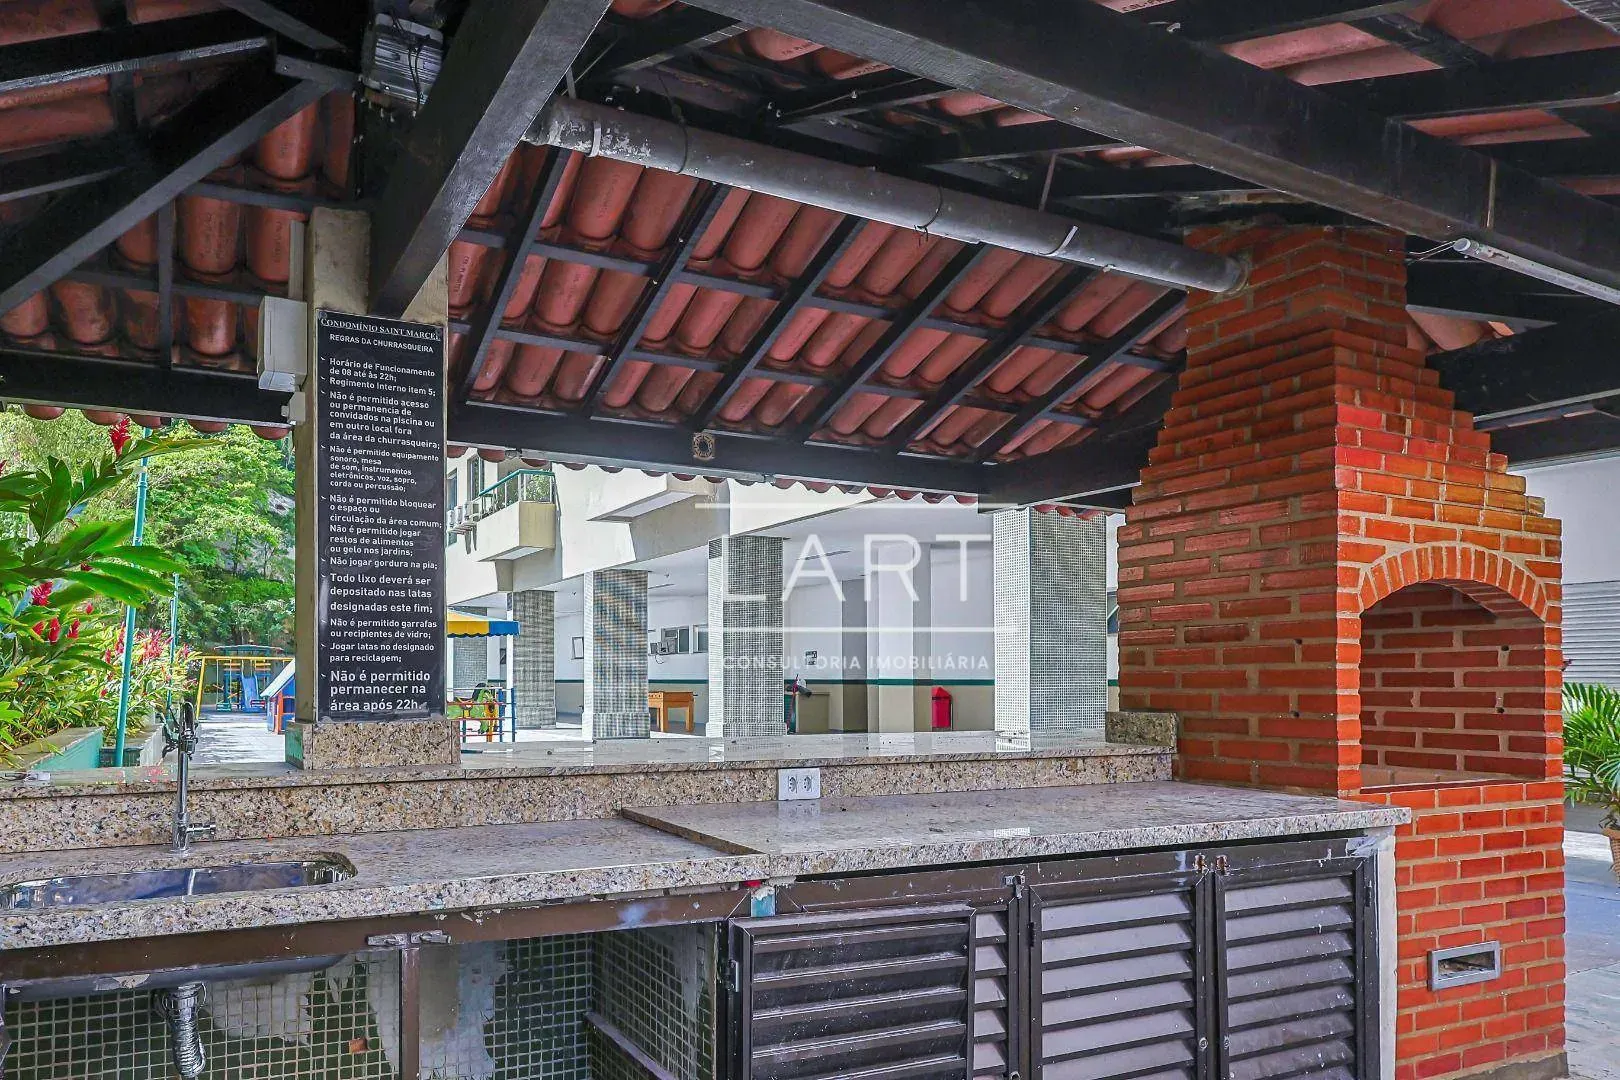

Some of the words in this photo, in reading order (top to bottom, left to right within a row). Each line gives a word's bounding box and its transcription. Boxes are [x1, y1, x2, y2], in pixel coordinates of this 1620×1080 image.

[321, 319, 378, 332] CONDOMÍNIO
[380, 326, 406, 335] SAINT
[330, 334, 359, 343] REGRAS
[373, 340, 433, 353] CHURRASQUEIRA
[330, 358, 360, 368] Horário
[375, 364, 435, 376] Funcionamento
[354, 369, 366, 377] até
[330, 377, 374, 389] Regimento
[377, 382, 406, 392] Interno
[408, 386, 426, 395] item
[330, 391, 346, 400] Não
[357, 395, 398, 405] permitido
[343, 403, 399, 414] permanencia
[330, 411, 378, 421] convidados
[394, 416, 422, 426] piscina
[346, 422, 369, 430] outro
[372, 424, 392, 433] local
[395, 426, 411, 434] fora
[343, 433, 362, 441] área
[354, 448, 390, 456] permitido
[392, 452, 439, 461] equipamento
[362, 465, 411, 475] instrumentos
[330, 495, 346, 503] Não
[357, 497, 397, 506] permitido
[400, 500, 436, 509] bloquear
[330, 514, 374, 524] circulação
[388, 517, 407, 525] área
[357, 527, 397, 535] permitido
[400, 529, 421, 537] jogar
[373, 537, 413, 546] alimentos
[343, 546, 361, 554] gelo
[349, 558, 372, 567] jogar
[330, 573, 355, 582] Todo
[358, 574, 376, 583] lixo
[379, 575, 412, 584] deverá
[330, 586, 385, 597] depositado
[408, 589, 432, 598] latas
[330, 602, 387, 613] designadas
[390, 603, 411, 612] este
[330, 618, 347, 626] Não
[350, 618, 354, 626] é
[358, 619, 399, 628] permitido
[401, 620, 437, 628] garrafas
[344, 630, 392, 639] recipientes
[330, 643, 354, 651] Jogar
[393, 643, 434, 652] designado
[330, 655, 349, 664] para
[330, 671, 355, 681] Não
[360, 670, 366, 681] é
[371, 671, 430, 683] permitido
[330, 685, 408, 696] permanecer
[330, 700, 359, 710] área
[363, 699, 392, 712] após
